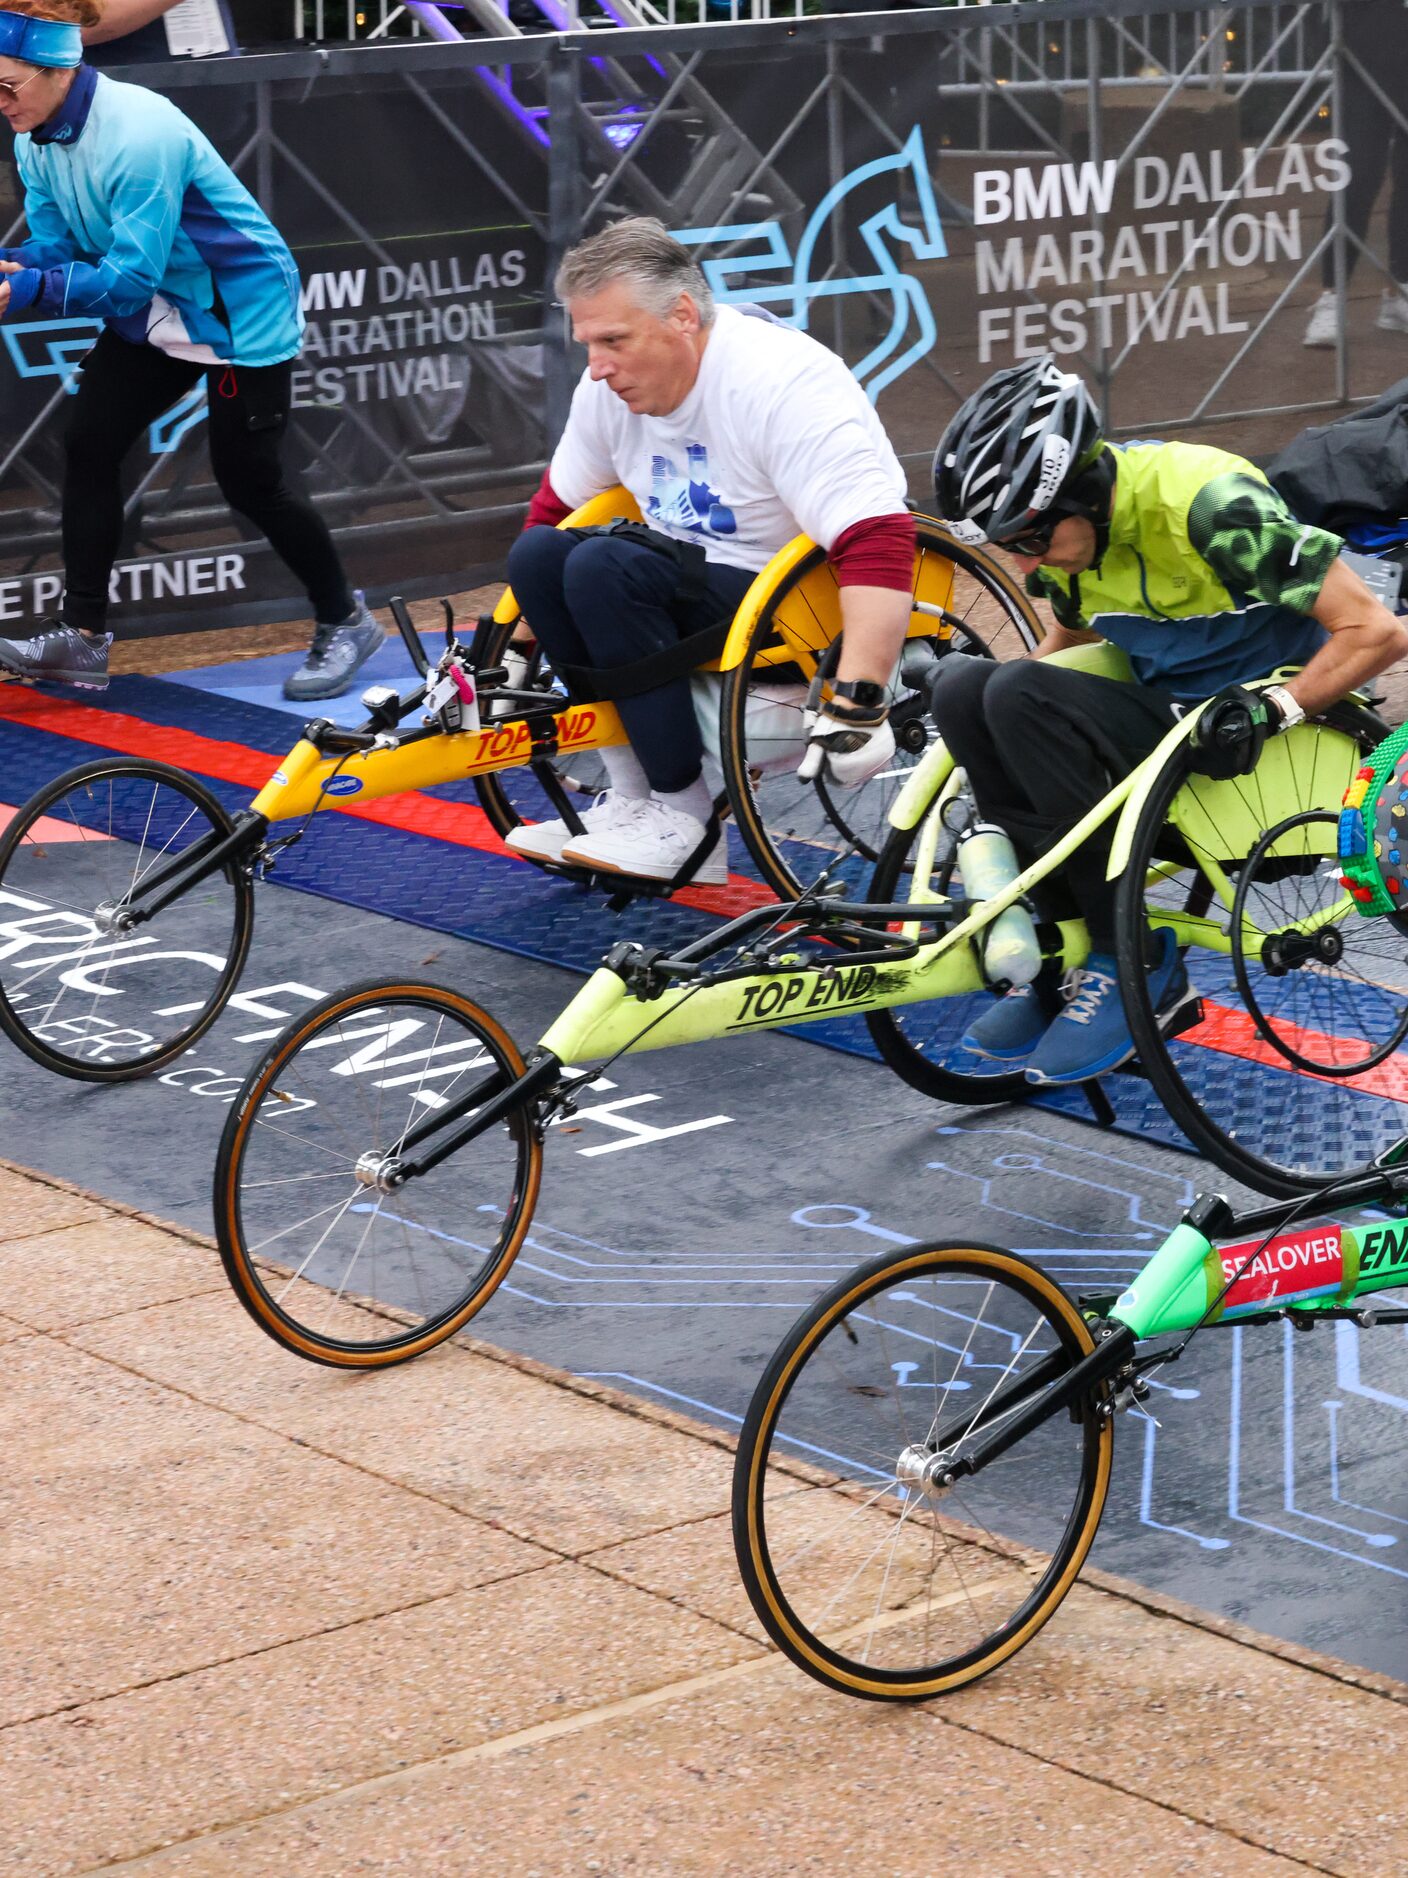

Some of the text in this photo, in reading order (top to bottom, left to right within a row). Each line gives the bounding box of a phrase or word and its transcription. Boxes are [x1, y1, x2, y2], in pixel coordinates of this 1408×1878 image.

[974, 138, 1352, 225] BMW DALLAS
[298, 250, 526, 312] MW DALLAS
[975, 208, 1302, 294] MARATHON
[295, 299, 497, 361] ARATHON
[978, 282, 1250, 363] FESTIVAL
[289, 353, 464, 409] ESTIVAL
[33, 554, 247, 614] PRTNER
[475, 711, 597, 761] TOP ND
[0, 890, 229, 996] RIC
[152, 980, 737, 1158] FINIH
[736, 965, 878, 1021] TOP END
[1221, 1236, 1343, 1284] SEALOVER
